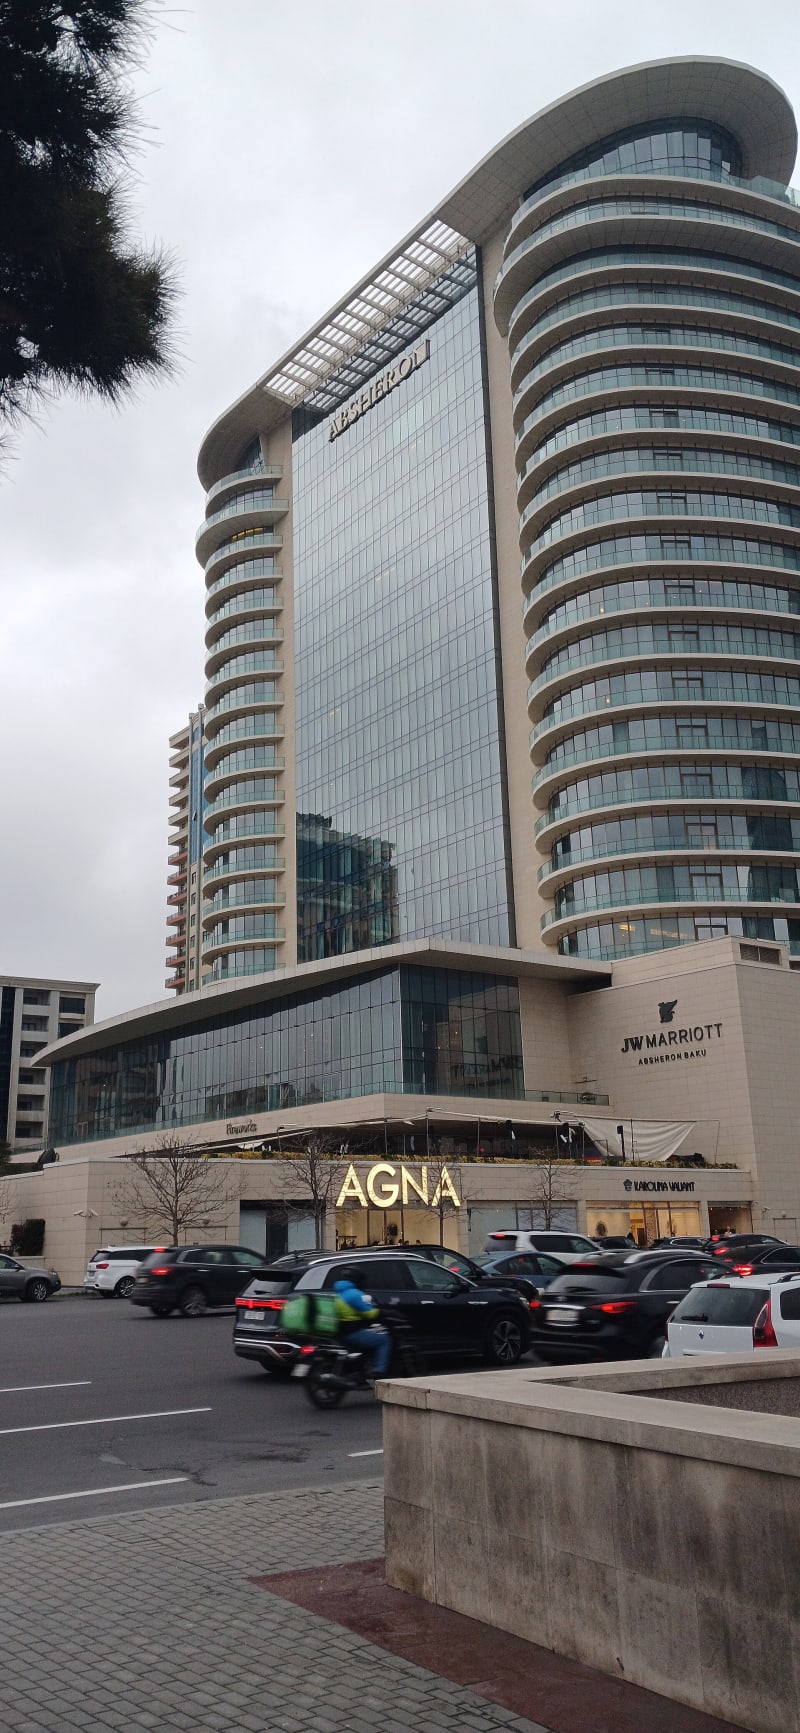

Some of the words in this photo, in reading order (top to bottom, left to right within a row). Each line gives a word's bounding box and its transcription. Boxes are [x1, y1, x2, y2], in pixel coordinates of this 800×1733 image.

[328, 339, 430, 443] ABSHERON
[621, 1036, 644, 1053] JW
[645, 1023, 722, 1049] MARRIOTT
[638, 1053, 682, 1066] ABSHERON
[684, 1049, 707, 1060] BAKU
[335, 1163, 461, 1208] AGNA
[634, 1181, 668, 1192] KAROLINA
[669, 1181, 695, 1192] VALIANT
